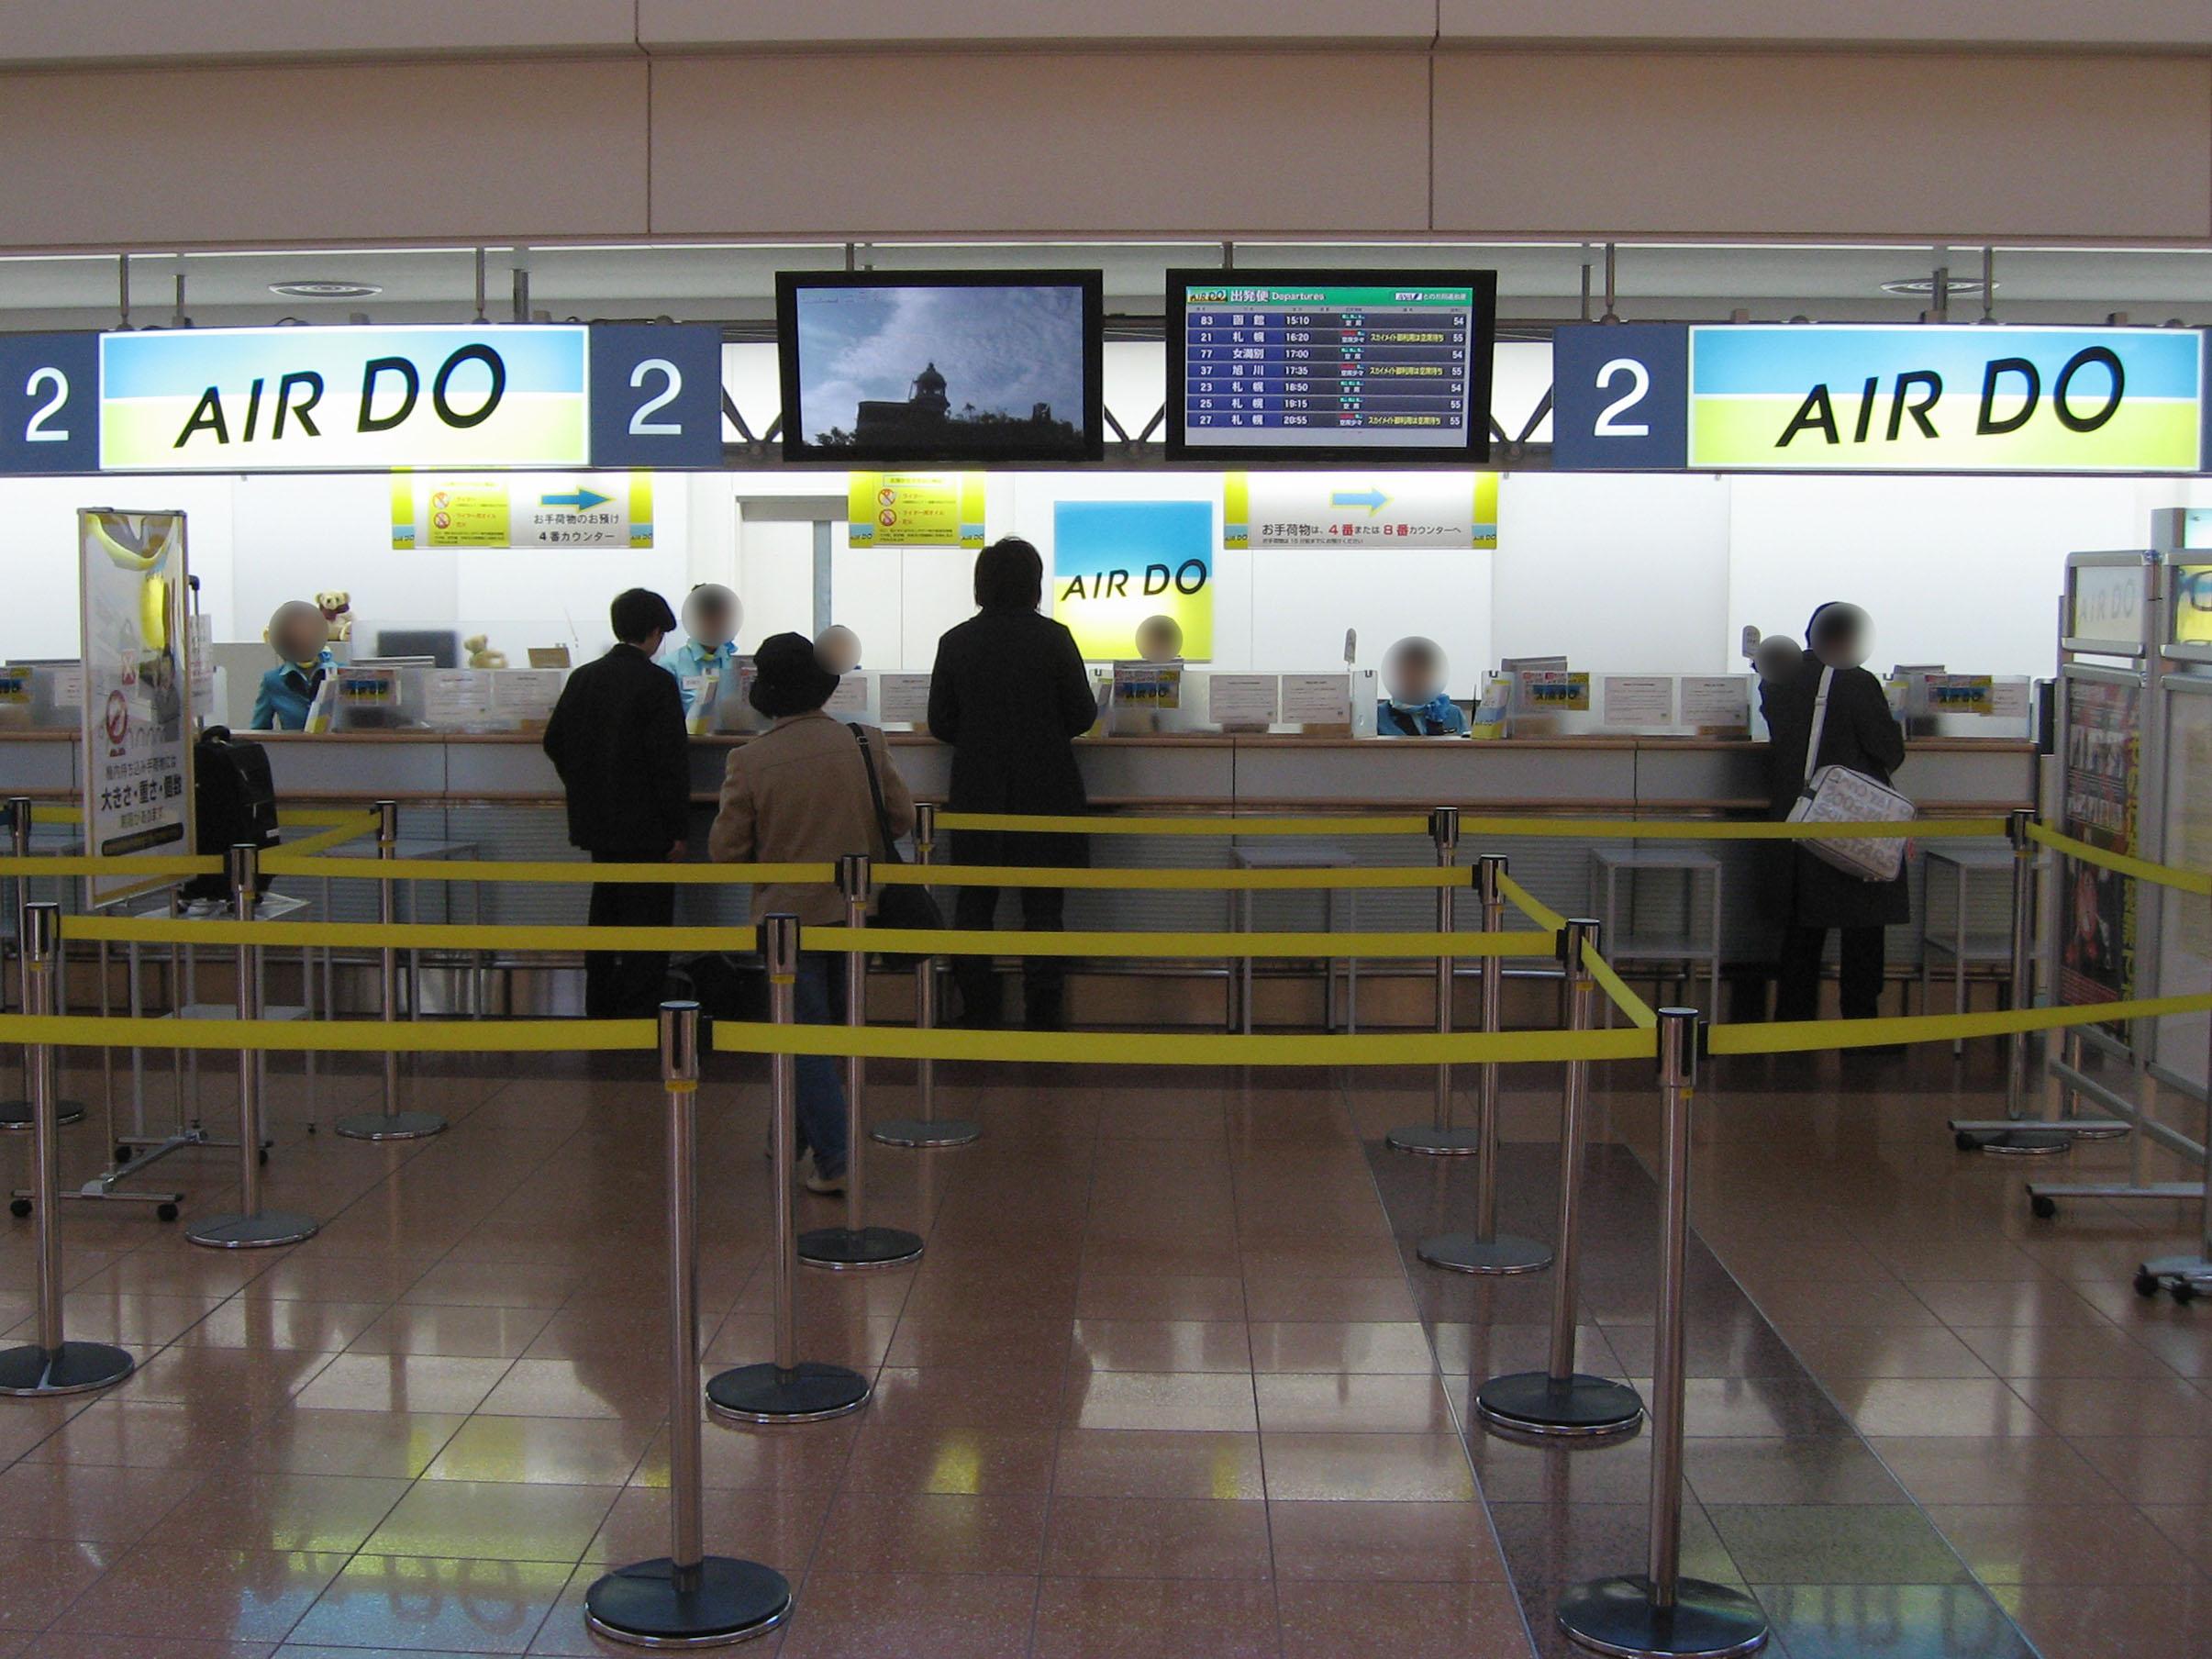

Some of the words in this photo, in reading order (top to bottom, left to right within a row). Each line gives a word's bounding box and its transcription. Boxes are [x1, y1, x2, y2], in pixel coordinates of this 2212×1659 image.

[1272, 292, 1325, 303] Departures
[1200, 316, 1213, 325] 83
[1285, 316, 1310, 325] 15:10
[1453, 317, 1464, 326] 54
[1200, 332, 1212, 342] 21
[1285, 332, 1310, 342] 16:20
[1452, 333, 1464, 342] 55
[1200, 349, 1213, 358] 77
[1232, 348, 1264, 359] 女満別
[1284, 350, 1309, 359] 17:00
[1451, 351, 1463, 359] 54
[1200, 366, 1213, 375] 37
[1231, 365, 1264, 376] 旭川
[1284, 366, 1309, 375] 17:35
[1451, 368, 1462, 376] 55
[1200, 383, 1213, 392] 23
[1284, 383, 1308, 392] 18:50
[1451, 384, 1462, 393] 54
[173, 370, 325, 448] AIR
[357, 343, 506, 434] DO
[628, 359, 684, 436] 2
[1594, 358, 1651, 437] 2
[1774, 369, 1943, 448] AIR
[1976, 346, 2126, 435] DO
[25, 367, 71, 442] 2
[1199, 398, 1212, 408] 25
[1284, 399, 1308, 408] 19:15
[1450, 400, 1462, 409] 55
[1199, 415, 1212, 425] 27
[1284, 416, 1308, 425] 20:55
[1450, 417, 1461, 426] 55
[534, 514, 620, 525] お手荷物のお預け
[1061, 568, 1129, 601] AIR
[1143, 558, 1207, 596] DO
[2111, 577, 2136, 619] DO
